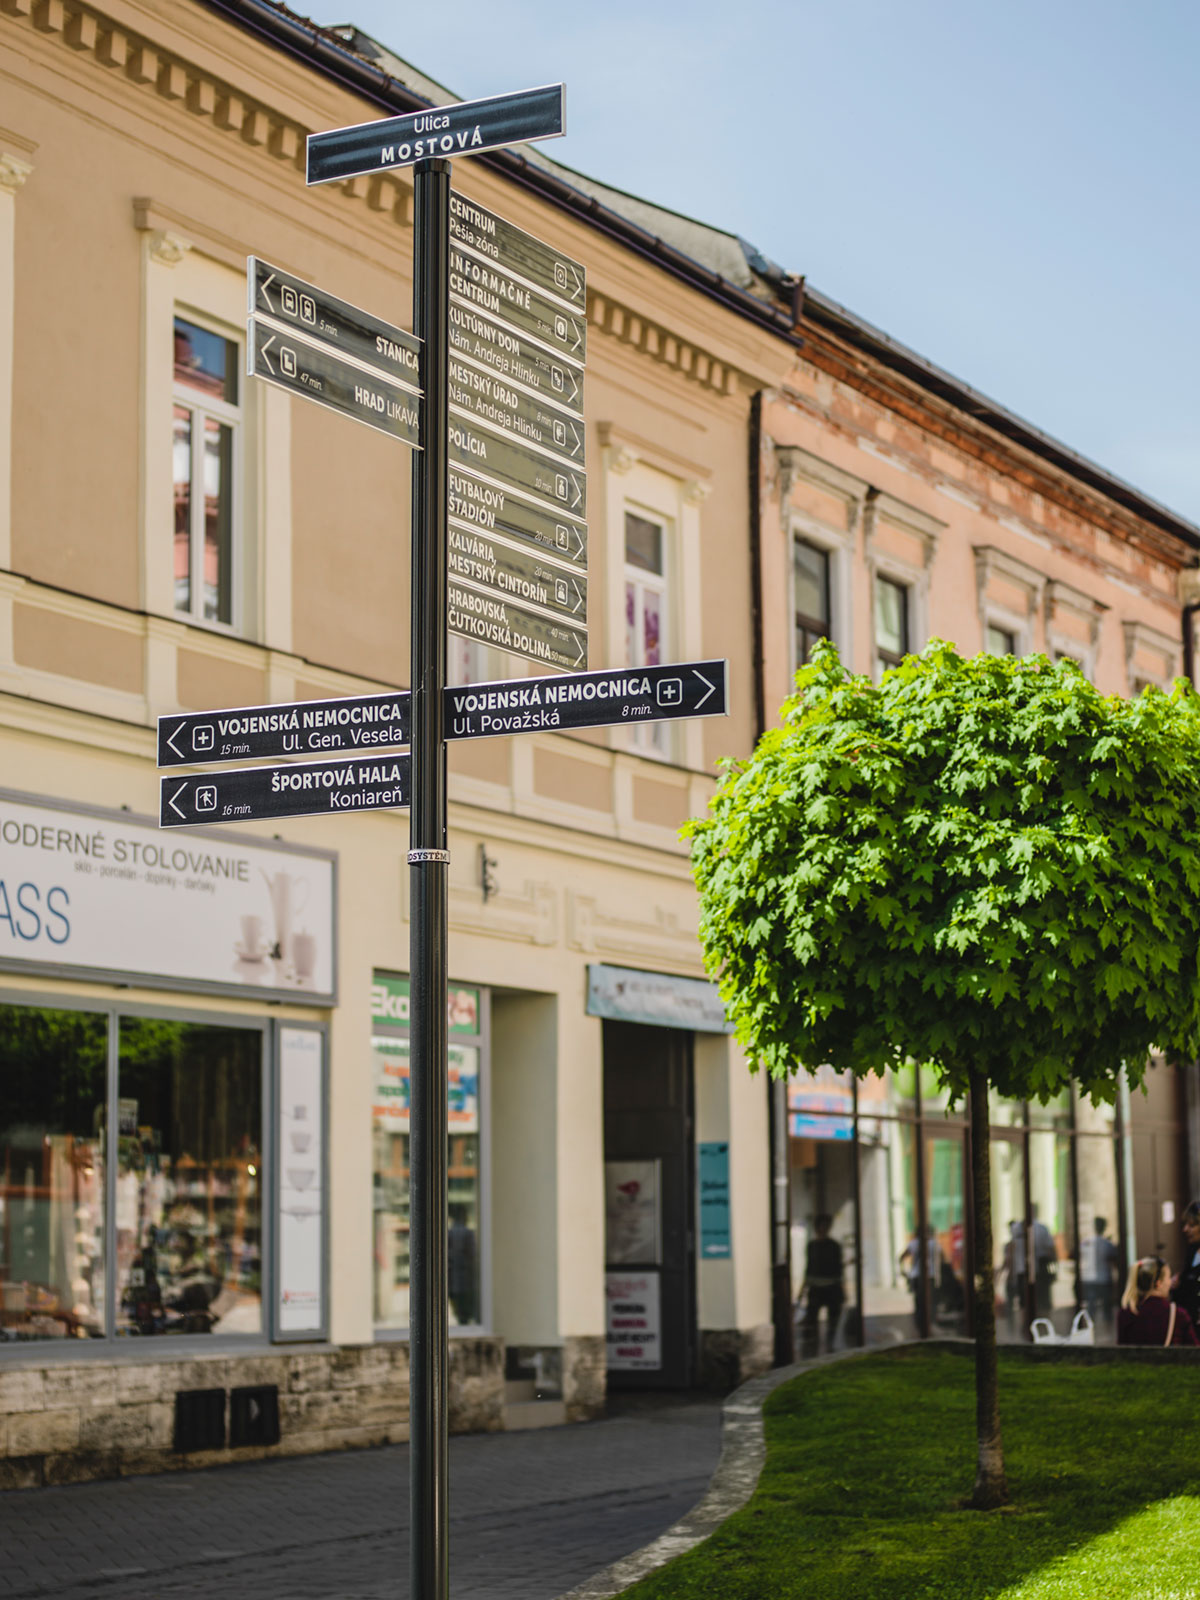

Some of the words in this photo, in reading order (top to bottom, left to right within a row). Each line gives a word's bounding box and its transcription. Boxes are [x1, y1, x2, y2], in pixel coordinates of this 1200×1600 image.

[414, 114, 450, 134] Ulica
[381, 125, 483, 164] MOSTOVÁ
[450, 197, 496, 236] CENTRUM
[450, 218, 474, 244] Pešia
[476, 236, 499, 258] zóna
[450, 252, 530, 310] INFORMAČNÉ
[450, 273, 500, 313] CENTRUM
[320, 320, 324, 330] 5
[325, 322, 338, 337] min.
[449, 306, 496, 344] KULTÚRNY
[498, 332, 520, 356] DOM
[541, 323, 552, 336] min.
[376, 336, 419, 372] STANICA
[449, 328, 472, 352] Nám.
[474, 341, 509, 372] Andreja
[511, 359, 540, 387] Hlinku
[300, 372, 309, 384] 47
[309, 376, 322, 390] min.
[449, 362, 492, 396] MESTSKÝ
[493, 382, 518, 408] ÚRAD
[355, 385, 384, 413] HRAD
[387, 402, 419, 429] LIKAVA
[449, 382, 474, 409] Nám.
[476, 397, 511, 428] Andreja
[513, 414, 542, 441] Hlinku
[448, 427, 486, 458] POLÍCIA
[449, 474, 504, 511] FUTBALOVÝ
[449, 492, 495, 528] ŠTADIÓN
[449, 530, 496, 566] KALVÁRIA,
[534, 530, 542, 542] 20
[448, 552, 496, 584] MESTSKÝ
[498, 572, 547, 604] CINTORÍN
[534, 566, 542, 577] 20
[448, 586, 509, 625] HRABOVSKÁ,
[448, 605, 511, 648] ČUTKOVSKÁ
[513, 632, 551, 660] DOLINA
[453, 684, 541, 712] VOJENSKÁ
[545, 677, 652, 705] NEMOCNICA
[622, 706, 629, 717] 8
[630, 704, 652, 716] min.
[218, 710, 300, 736] VOJENSKÁ
[303, 703, 401, 728] NEMOCNICA
[453, 715, 476, 734] Ul.
[481, 708, 560, 732] Považská
[220, 744, 231, 755] 15
[232, 742, 251, 754] min.
[282, 734, 303, 751] Ul.
[308, 732, 345, 749] Gen.
[350, 725, 402, 746] Vesela
[271, 765, 355, 792] ŠPORTOVÁ
[359, 764, 401, 782] HALA
[222, 804, 233, 815] 16
[234, 803, 252, 814] min.
[330, 786, 402, 808] Koniareň
[0, 815, 105, 859] ODERNÉ
[113, 839, 250, 883] STOLOVANIE
